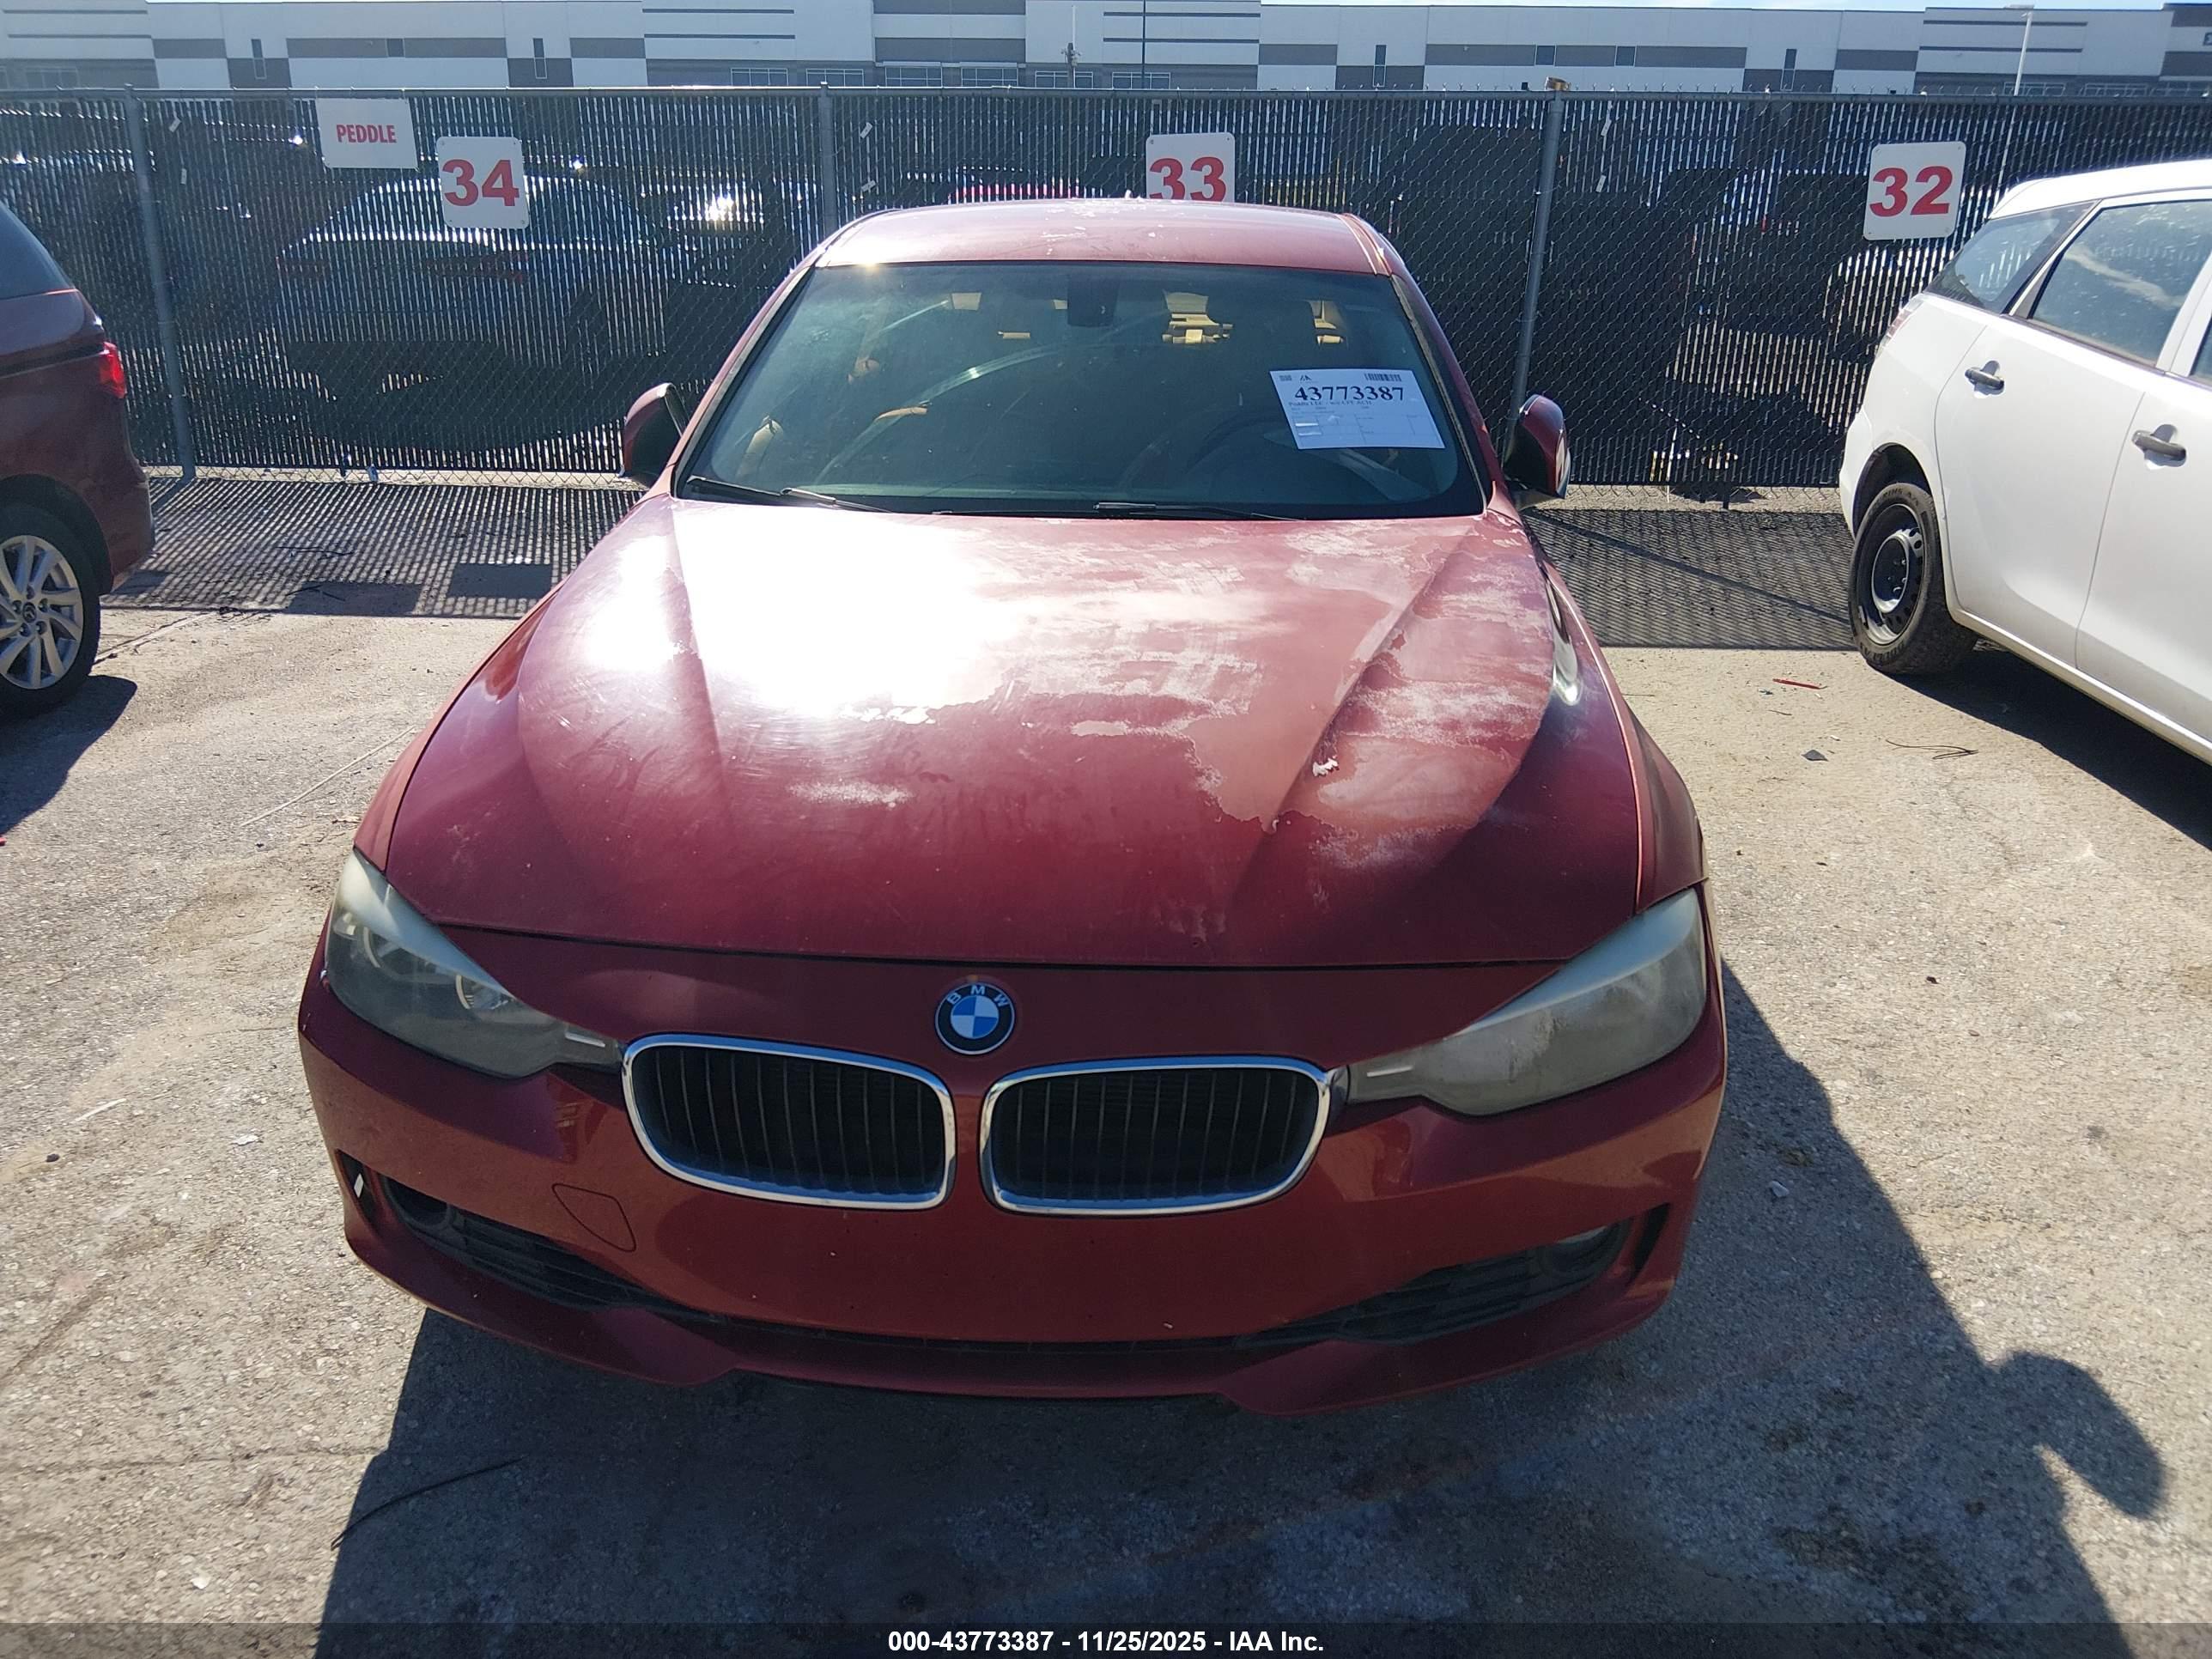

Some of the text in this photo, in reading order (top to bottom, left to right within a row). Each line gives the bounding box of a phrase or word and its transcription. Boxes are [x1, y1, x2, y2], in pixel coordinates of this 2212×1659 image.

[336, 125, 398, 143] PEDDLE
[442, 159, 520, 207] 34
[1149, 156, 1227, 202] 33
[1869, 166, 1953, 217] 32
[1294, 386, 1404, 401] 43773387
[946, 984, 1009, 1007] BMW
